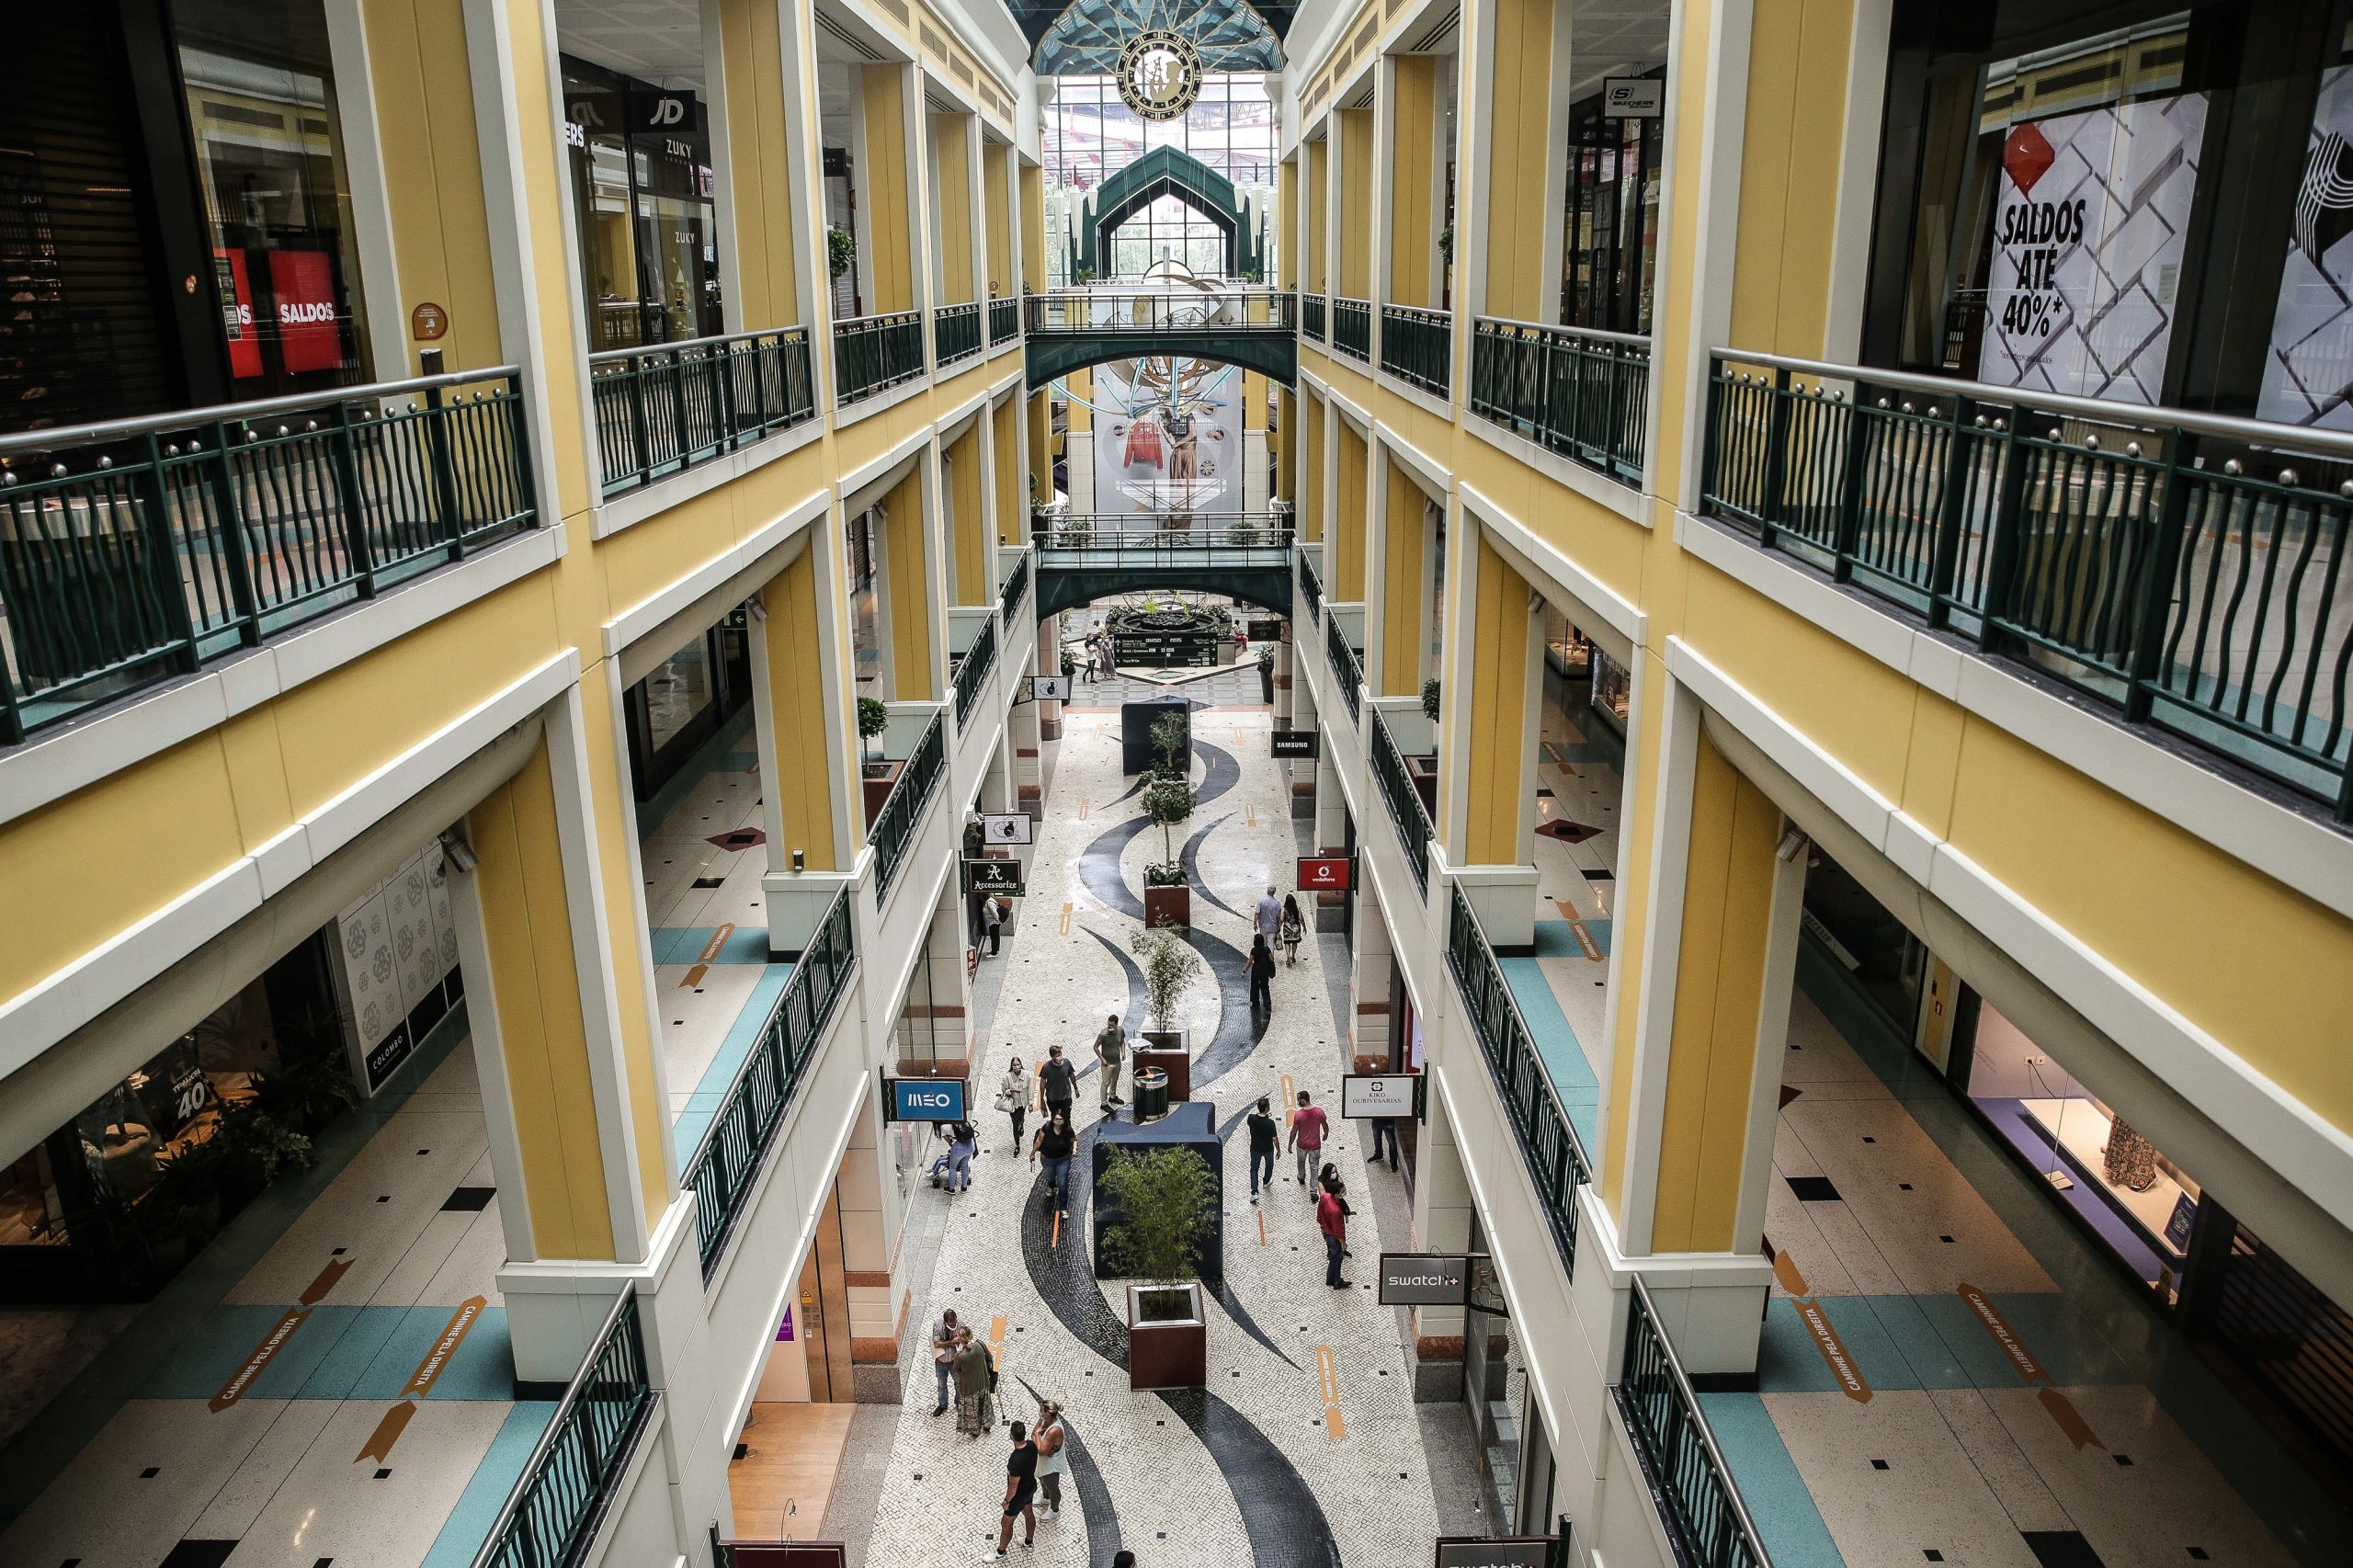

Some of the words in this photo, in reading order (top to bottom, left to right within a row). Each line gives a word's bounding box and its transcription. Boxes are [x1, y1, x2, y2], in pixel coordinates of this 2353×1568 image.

[650, 97, 684, 125] JD
[665, 139, 692, 159] ZUKY
[2003, 199, 2086, 245] SALDOS
[675, 231, 695, 244] ZUKY
[2016, 243, 2059, 290] ATÉ
[280, 301, 335, 324] SALDOS
[974, 881, 1017, 890] Accessorize
[373, 1035, 403, 1070] COLOMBO
[907, 1093, 950, 1108] MEO
[1388, 1274, 1449, 1286] swatch
[448, 1305, 476, 1337] CAMINHE
[1805, 1308, 1829, 1335] DIREITA
[1968, 1293, 1999, 1324] CAMINHE
[1992, 1324, 2013, 1344] PELA
[2006, 1344, 2037, 1373] DIREITA
[222, 1365, 258, 1400] CAMINHE
[252, 1345, 276, 1365] PELA
[268, 1317, 300, 1346] DIREITA
[437, 1337, 456, 1356] PELA
[1821, 1336, 1841, 1355] PELA
[415, 1357, 443, 1386] DIREITA
[1832, 1355, 1861, 1391] CAMINHE
